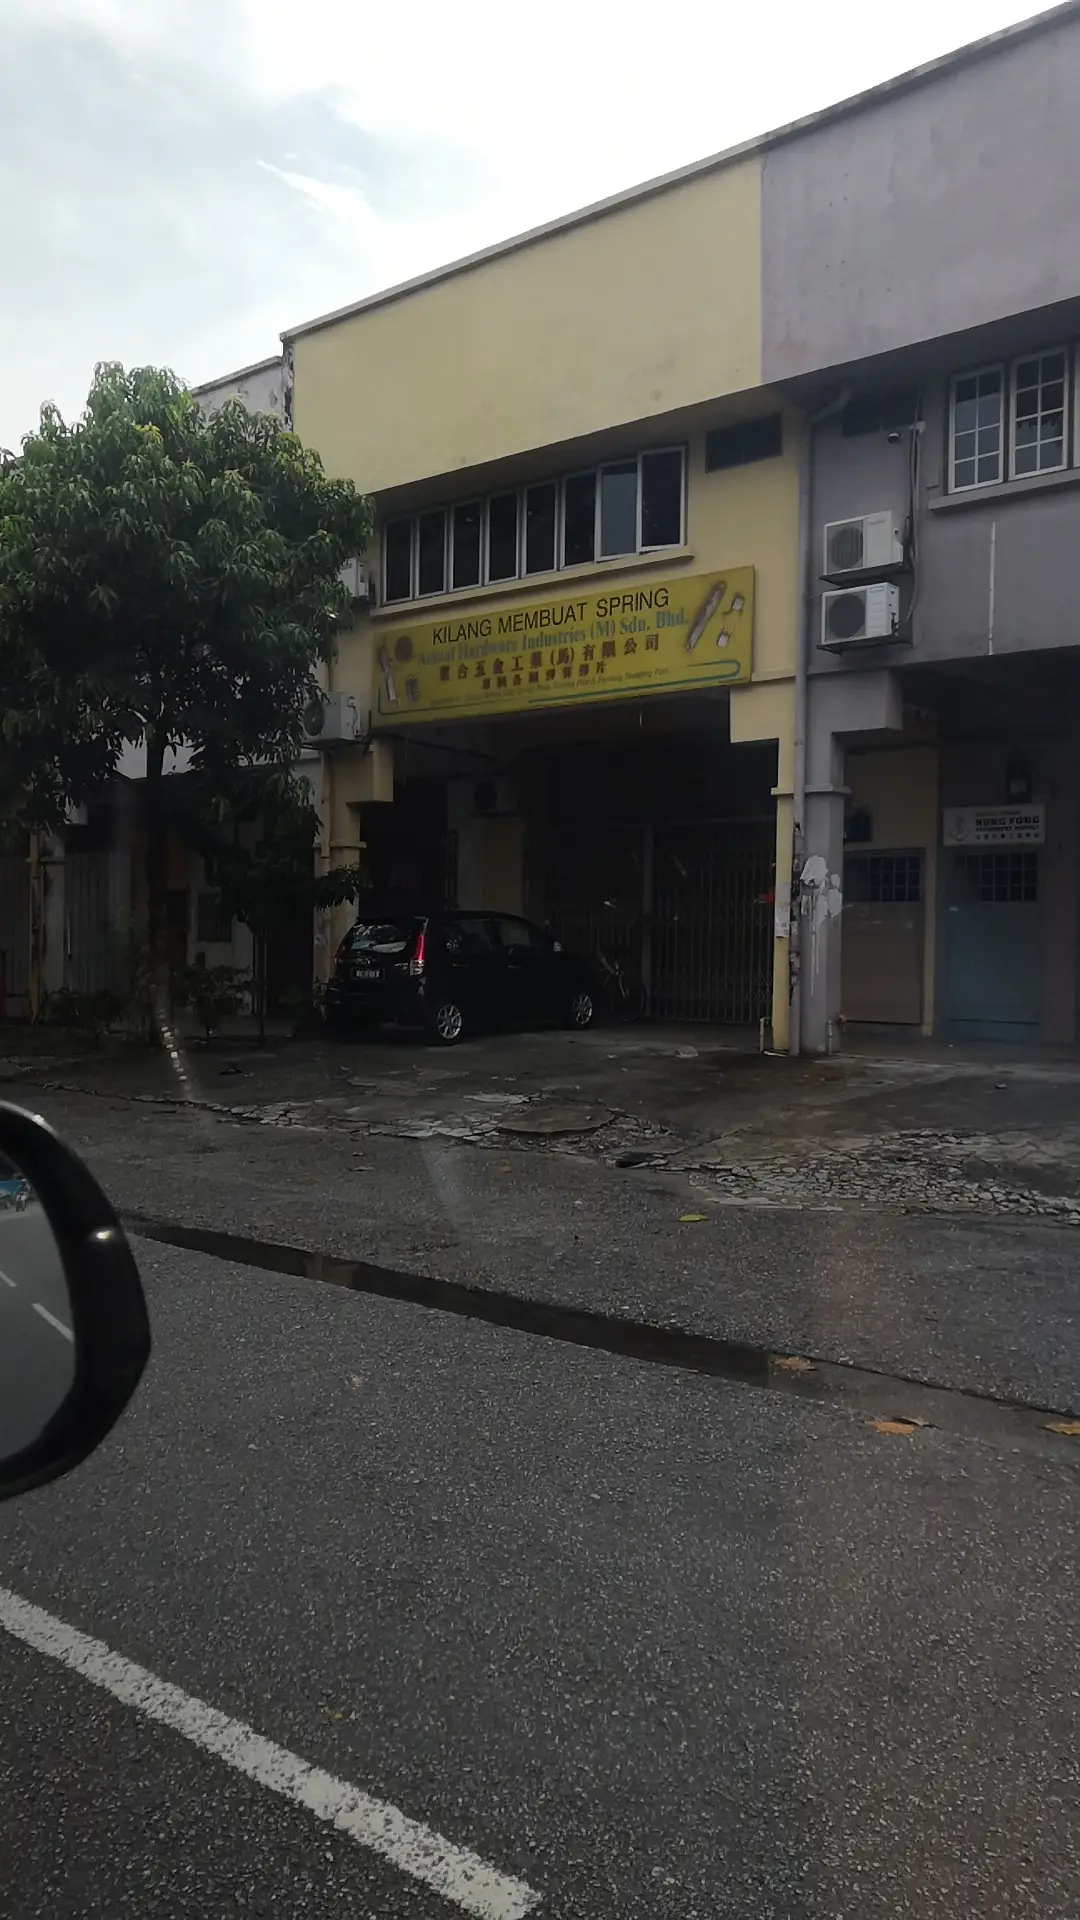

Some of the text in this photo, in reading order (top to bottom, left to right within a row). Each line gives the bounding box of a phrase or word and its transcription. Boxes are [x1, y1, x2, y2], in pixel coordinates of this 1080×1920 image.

[433, 588, 669, 646] KILANG MEMBUAT SPRING
[523, 627, 586, 650] Industries
[590, 619, 616, 640] (M)
[620, 615, 650, 635] Sdn.
